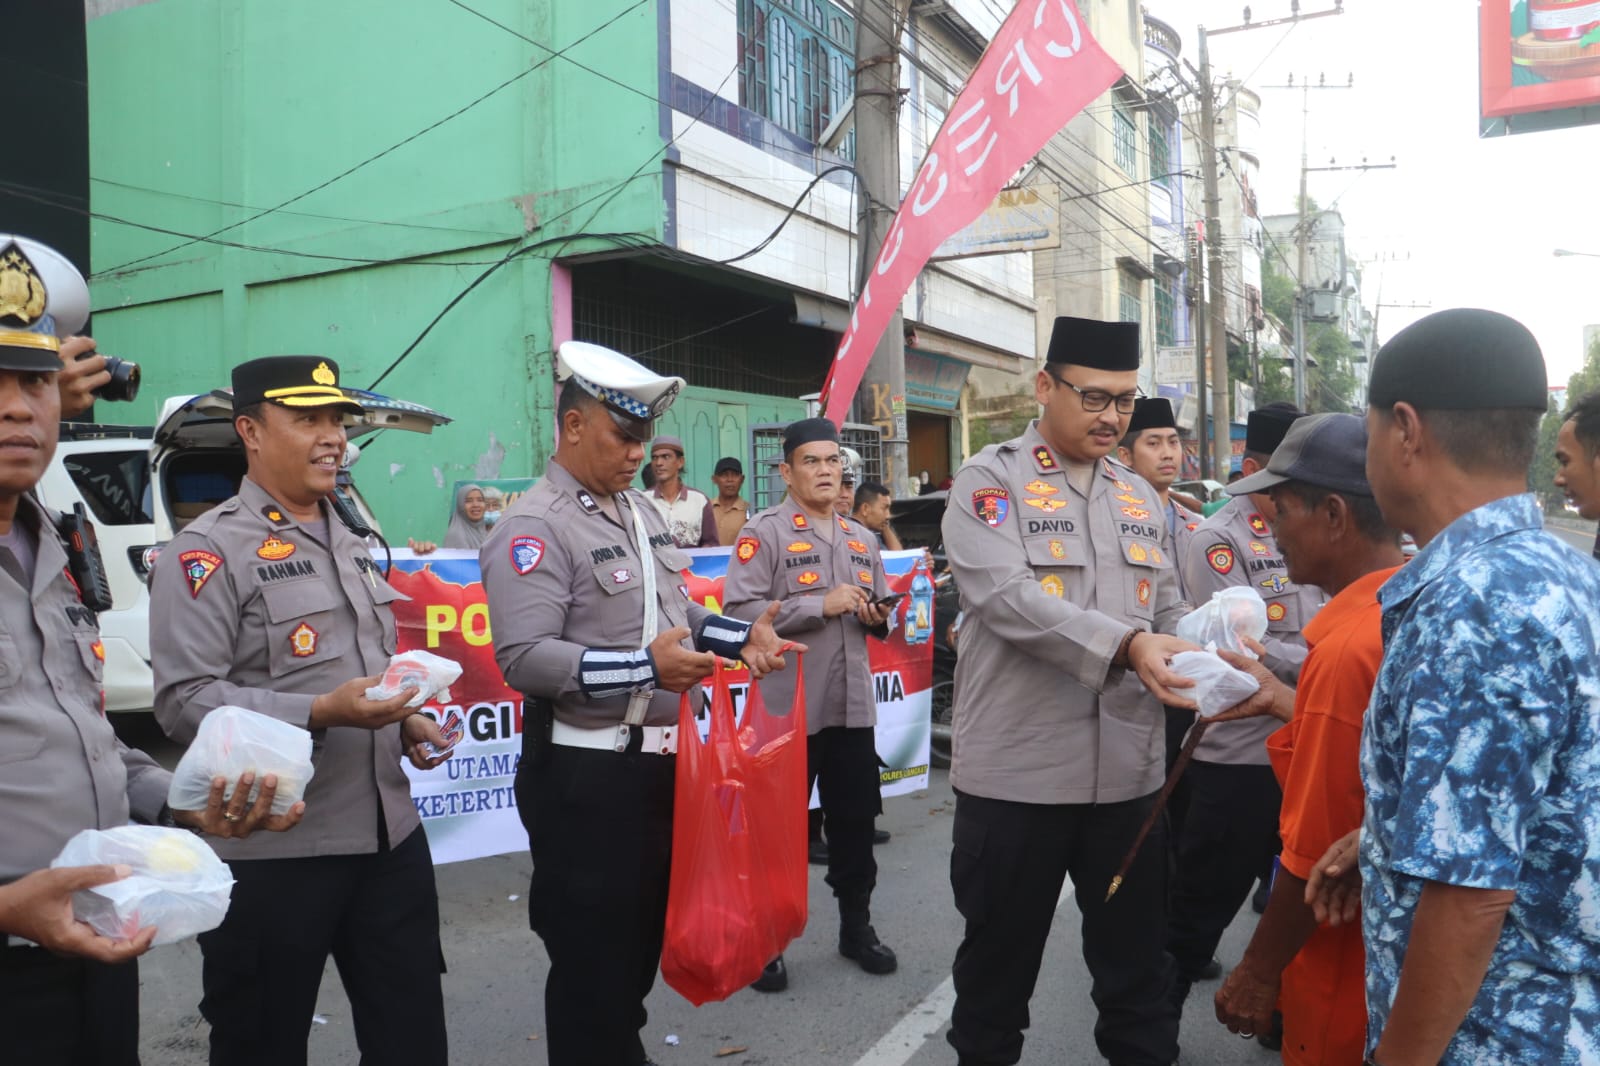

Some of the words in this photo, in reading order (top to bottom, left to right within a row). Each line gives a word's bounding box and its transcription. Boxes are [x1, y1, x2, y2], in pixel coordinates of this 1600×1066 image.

[975, 488, 1006, 497] PROPAM
[1029, 520, 1074, 534] DAVID
[1121, 523, 1158, 540] POLRI
[257, 560, 316, 582] RAHMAN
